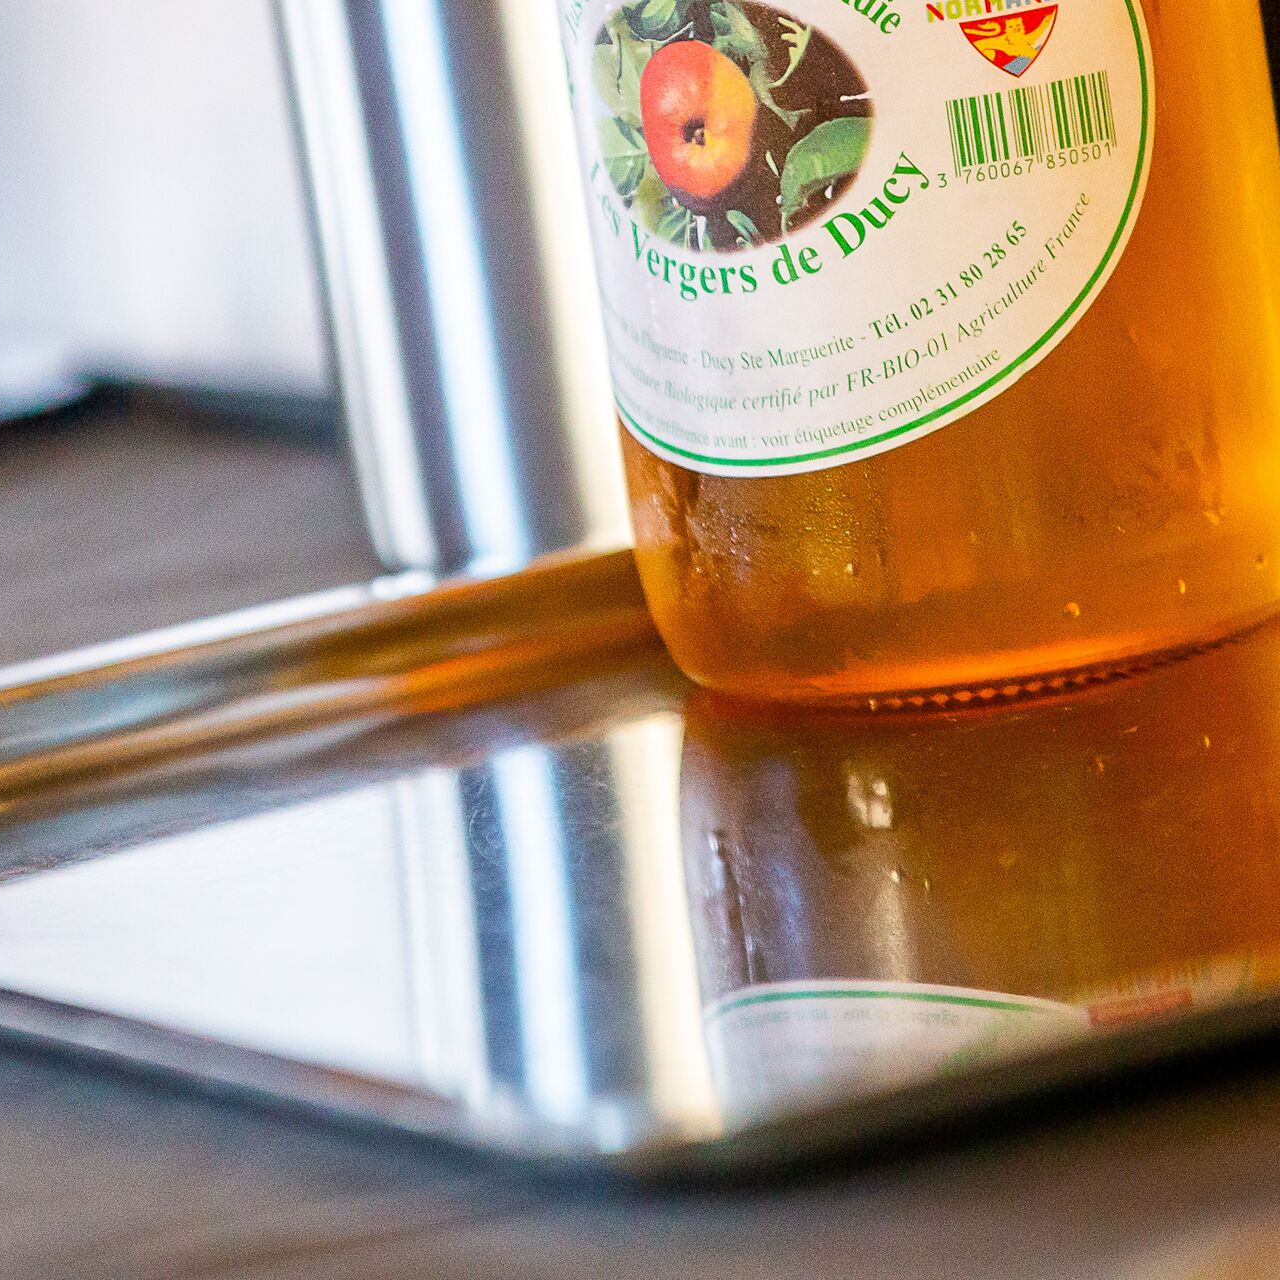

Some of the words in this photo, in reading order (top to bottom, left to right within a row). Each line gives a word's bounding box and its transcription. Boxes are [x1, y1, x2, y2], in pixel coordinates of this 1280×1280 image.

[628, 218, 758, 301] Vergers
[771, 242, 823, 286] de
[819, 150, 930, 260] Ducy
[937, 172, 948, 189] 3
[963, 158, 1035, 185] 760067
[1045, 143, 1113, 170] 850501
[663, 379, 738, 415] Biologique
[741, 384, 803, 414] certifié
[808, 382, 840, 405] par
[846, 331, 951, 393] FR-BIO-01
[955, 257, 1047, 343] Agriculture
[1043, 190, 1091, 261] France
[701, 350, 736, 376] Ducy
[740, 350, 764, 370] Ste
[767, 333, 856, 369] Marguerite
[868, 312, 909, 340] Tél.
[909, 296, 934, 322] 02
[934, 280, 959, 307] 31
[958, 263, 983, 289] 80
[982, 242, 1007, 269] 28
[1005, 219, 1028, 248] 65
[712, 434, 748, 450] avant
[760, 430, 791, 449] voir
[794, 414, 874, 444] étiquetage
[877, 347, 1002, 422] complémentaire
